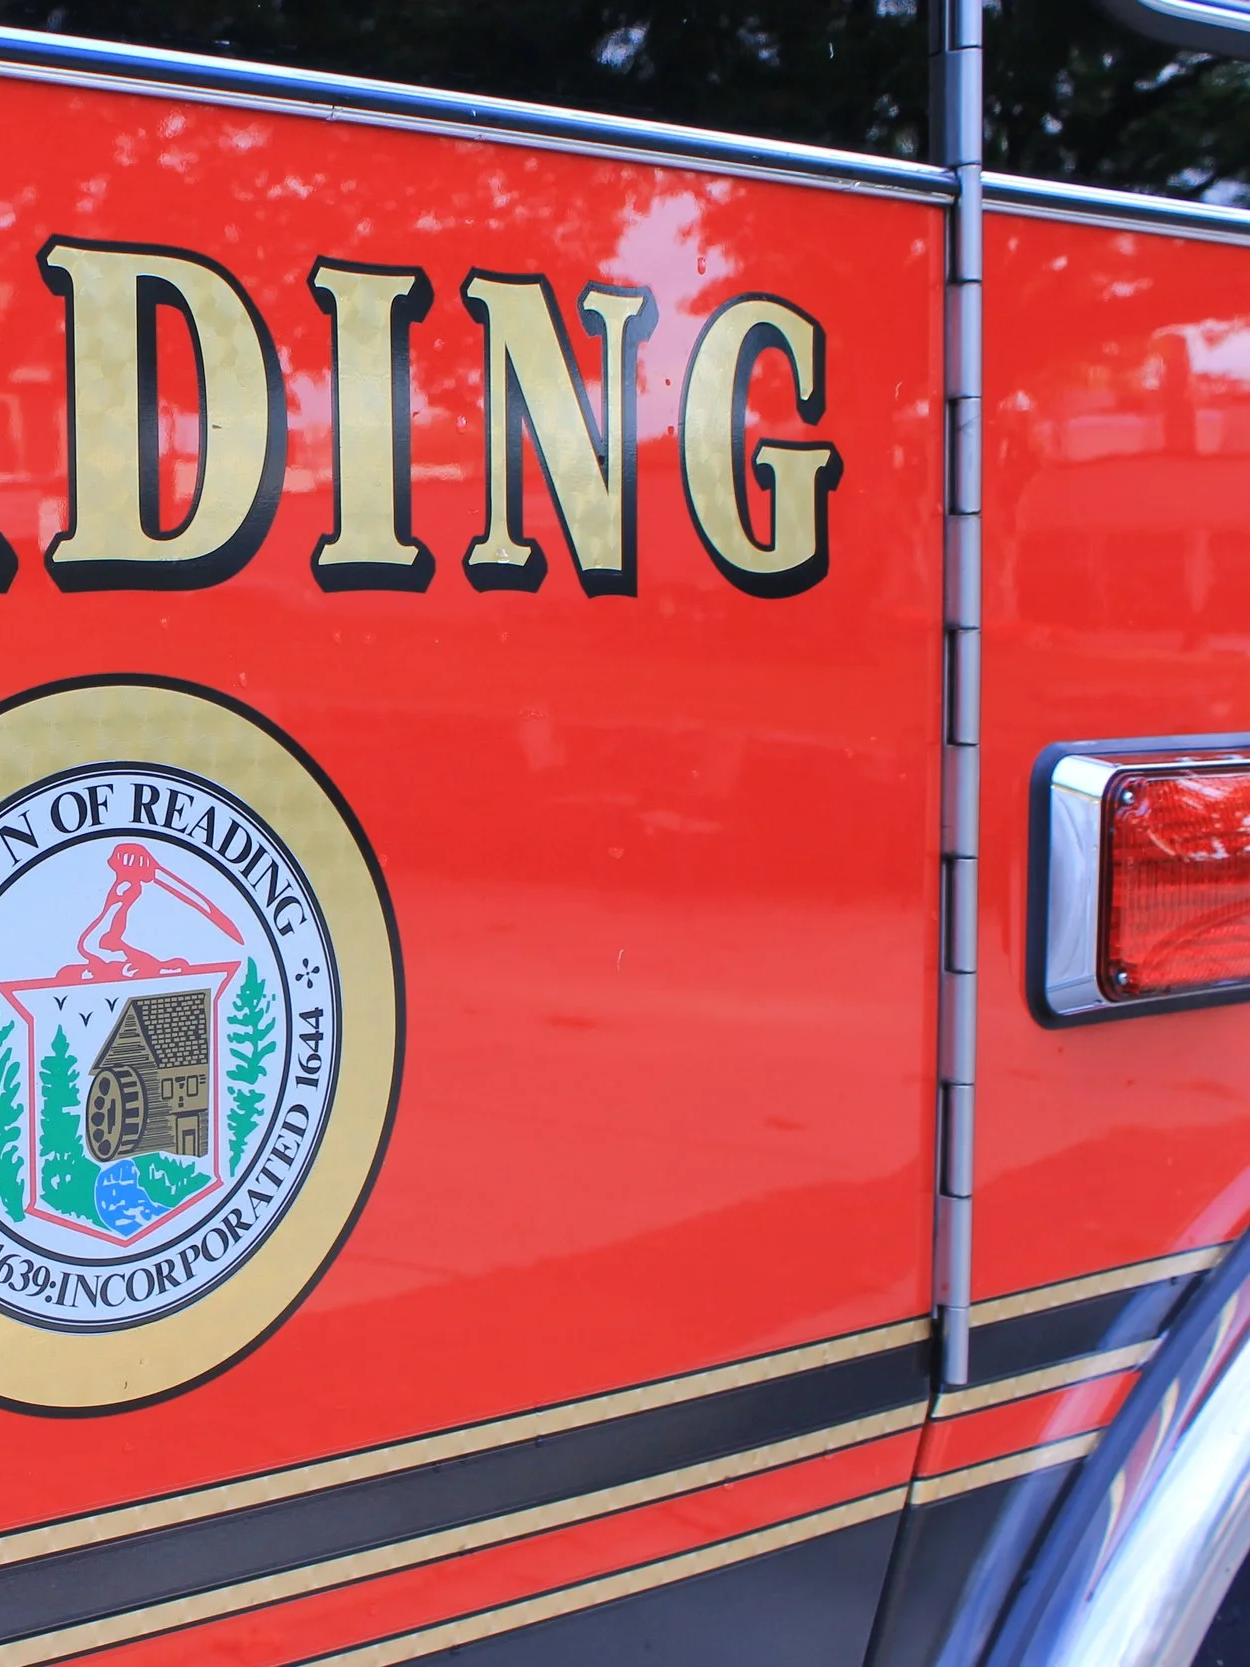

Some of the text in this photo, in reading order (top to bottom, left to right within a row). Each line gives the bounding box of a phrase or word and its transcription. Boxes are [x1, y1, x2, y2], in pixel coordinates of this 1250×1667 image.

[50, 784, 114, 834] OF
[129, 782, 308, 937] READING
[295, 1006, 324, 1092] 1644
